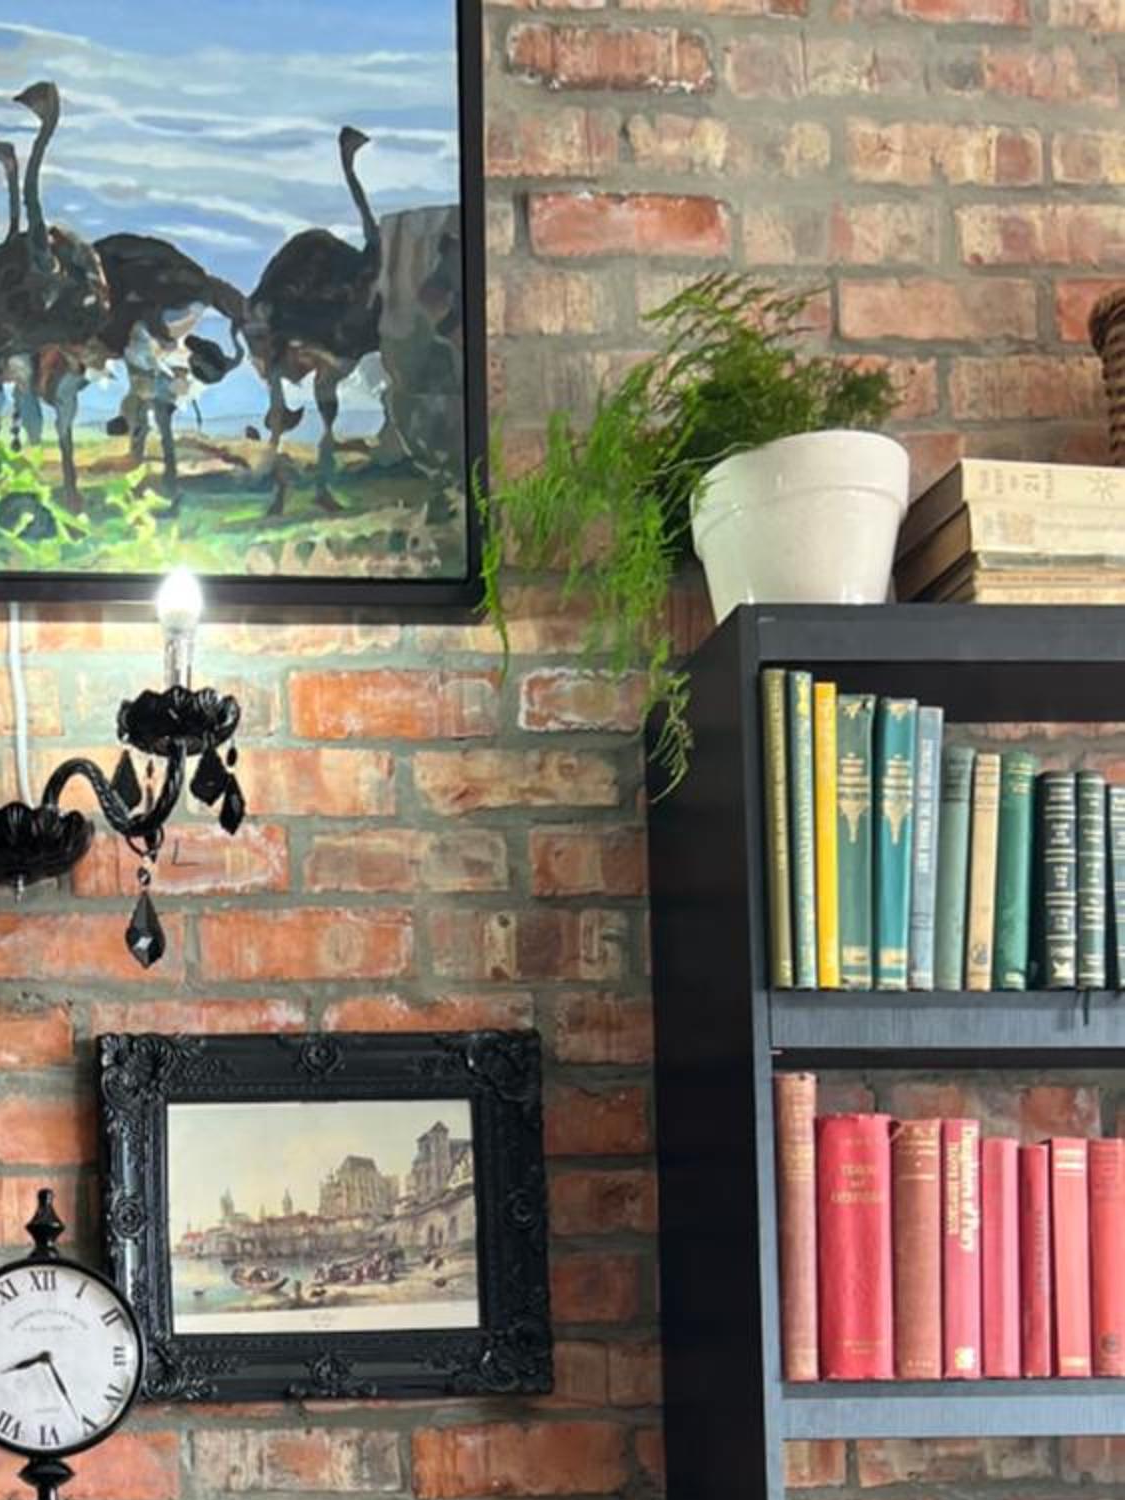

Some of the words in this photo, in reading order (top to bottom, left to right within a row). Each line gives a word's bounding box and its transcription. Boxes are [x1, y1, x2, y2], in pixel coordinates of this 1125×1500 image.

[30, 1270, 57, 1292] XII
[75, 1279, 89, 1300] I
[100, 1307, 125, 1328] II
[112, 1346, 127, 1367] III
[39, 1425, 61, 1447] VI
[81, 1415, 99, 1438] V
